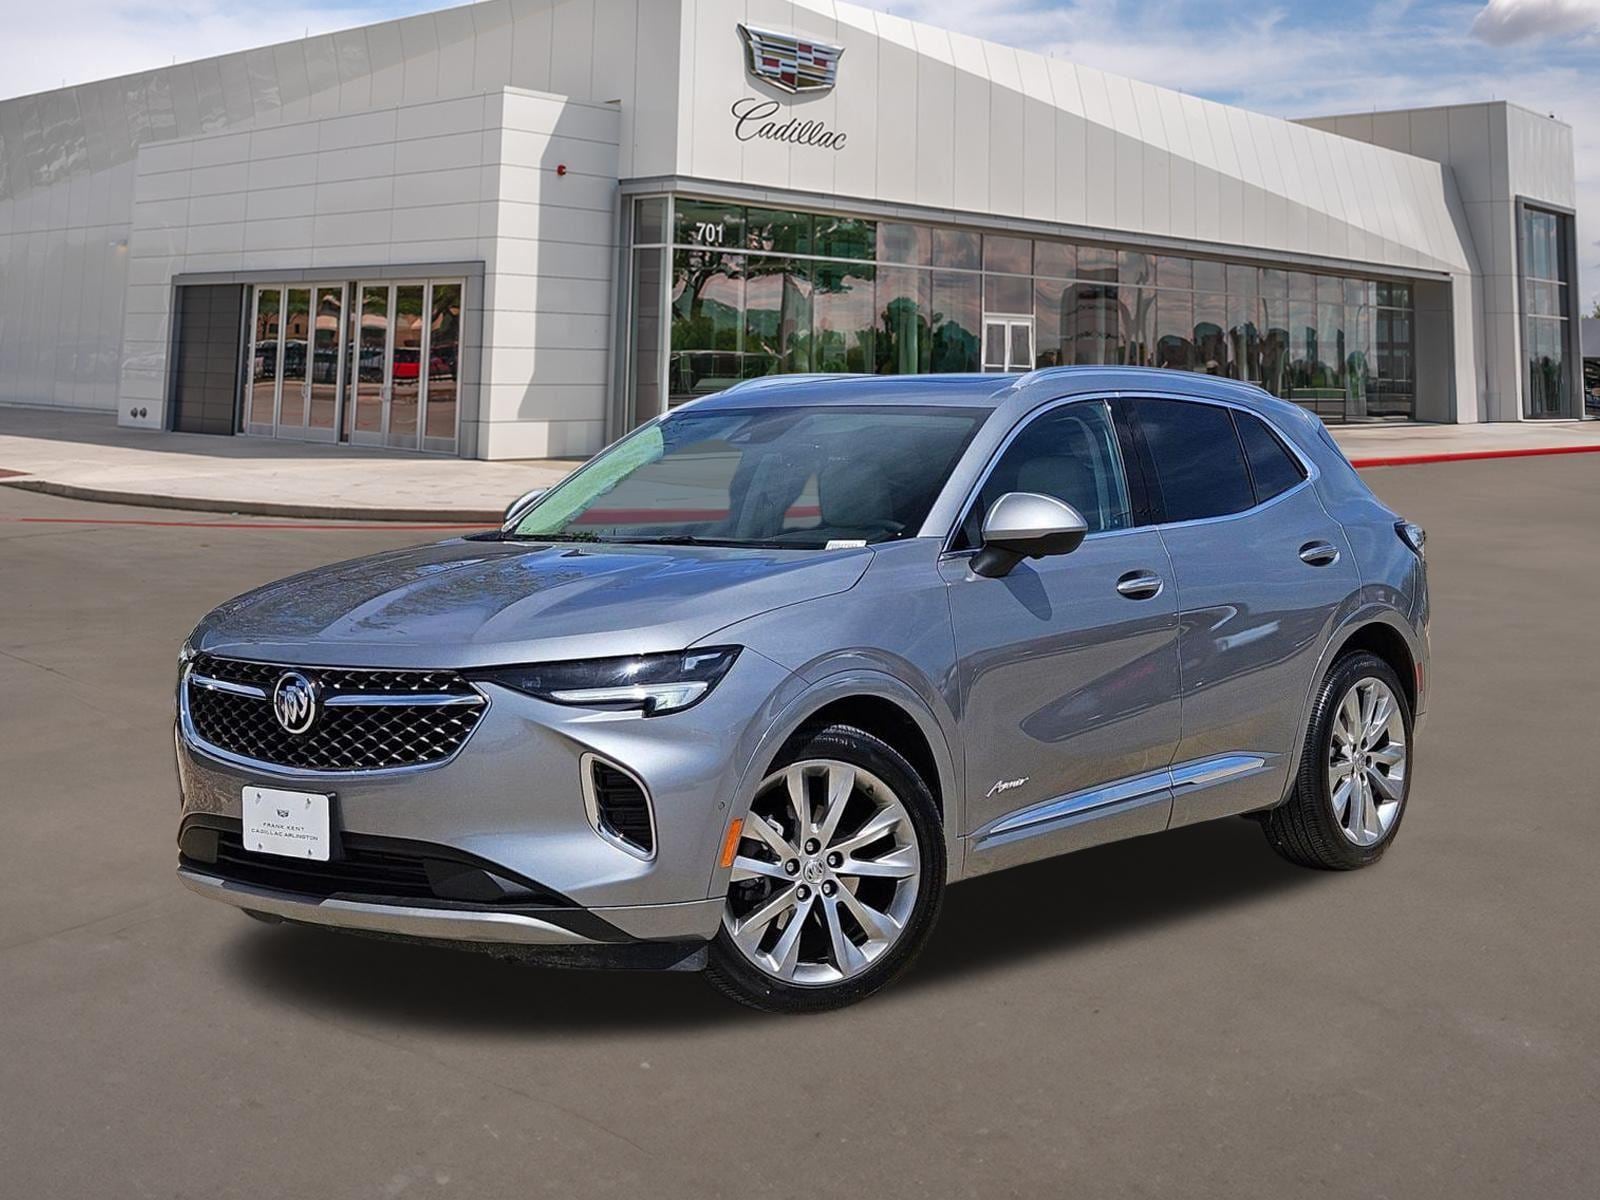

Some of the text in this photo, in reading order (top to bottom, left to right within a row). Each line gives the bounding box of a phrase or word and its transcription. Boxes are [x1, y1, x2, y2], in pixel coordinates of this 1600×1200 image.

[731, 97, 847, 150] Cadillac
[696, 222, 723, 243] 701
[251, 828, 318, 841] CADILLAC ARLINGTON
